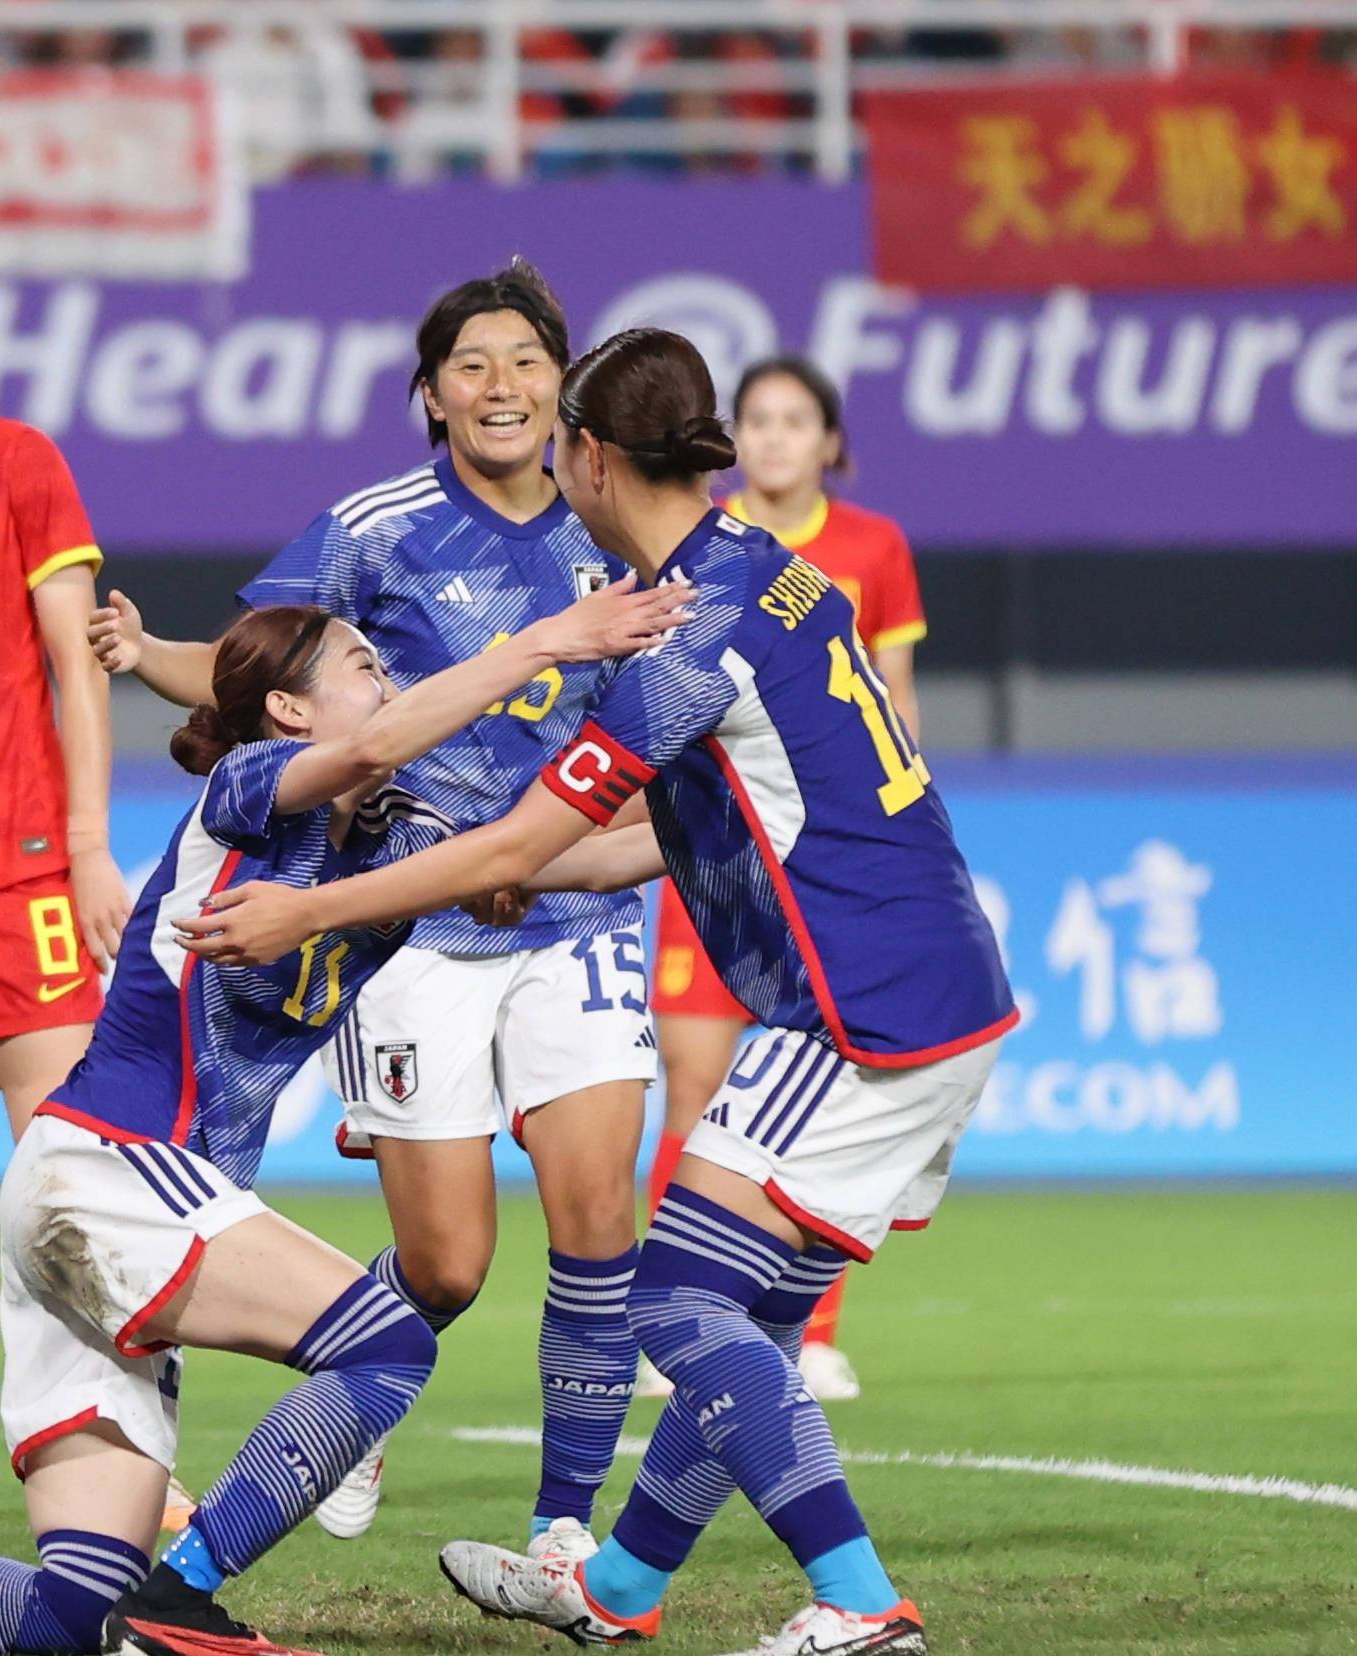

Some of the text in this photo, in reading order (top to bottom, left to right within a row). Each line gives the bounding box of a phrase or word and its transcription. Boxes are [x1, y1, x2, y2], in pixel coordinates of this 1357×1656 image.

[557, 739, 612, 794] C
[29, 895, 80, 976] 8
[570, 931, 648, 1016] 15
[972, 841, 1225, 1045] 信
